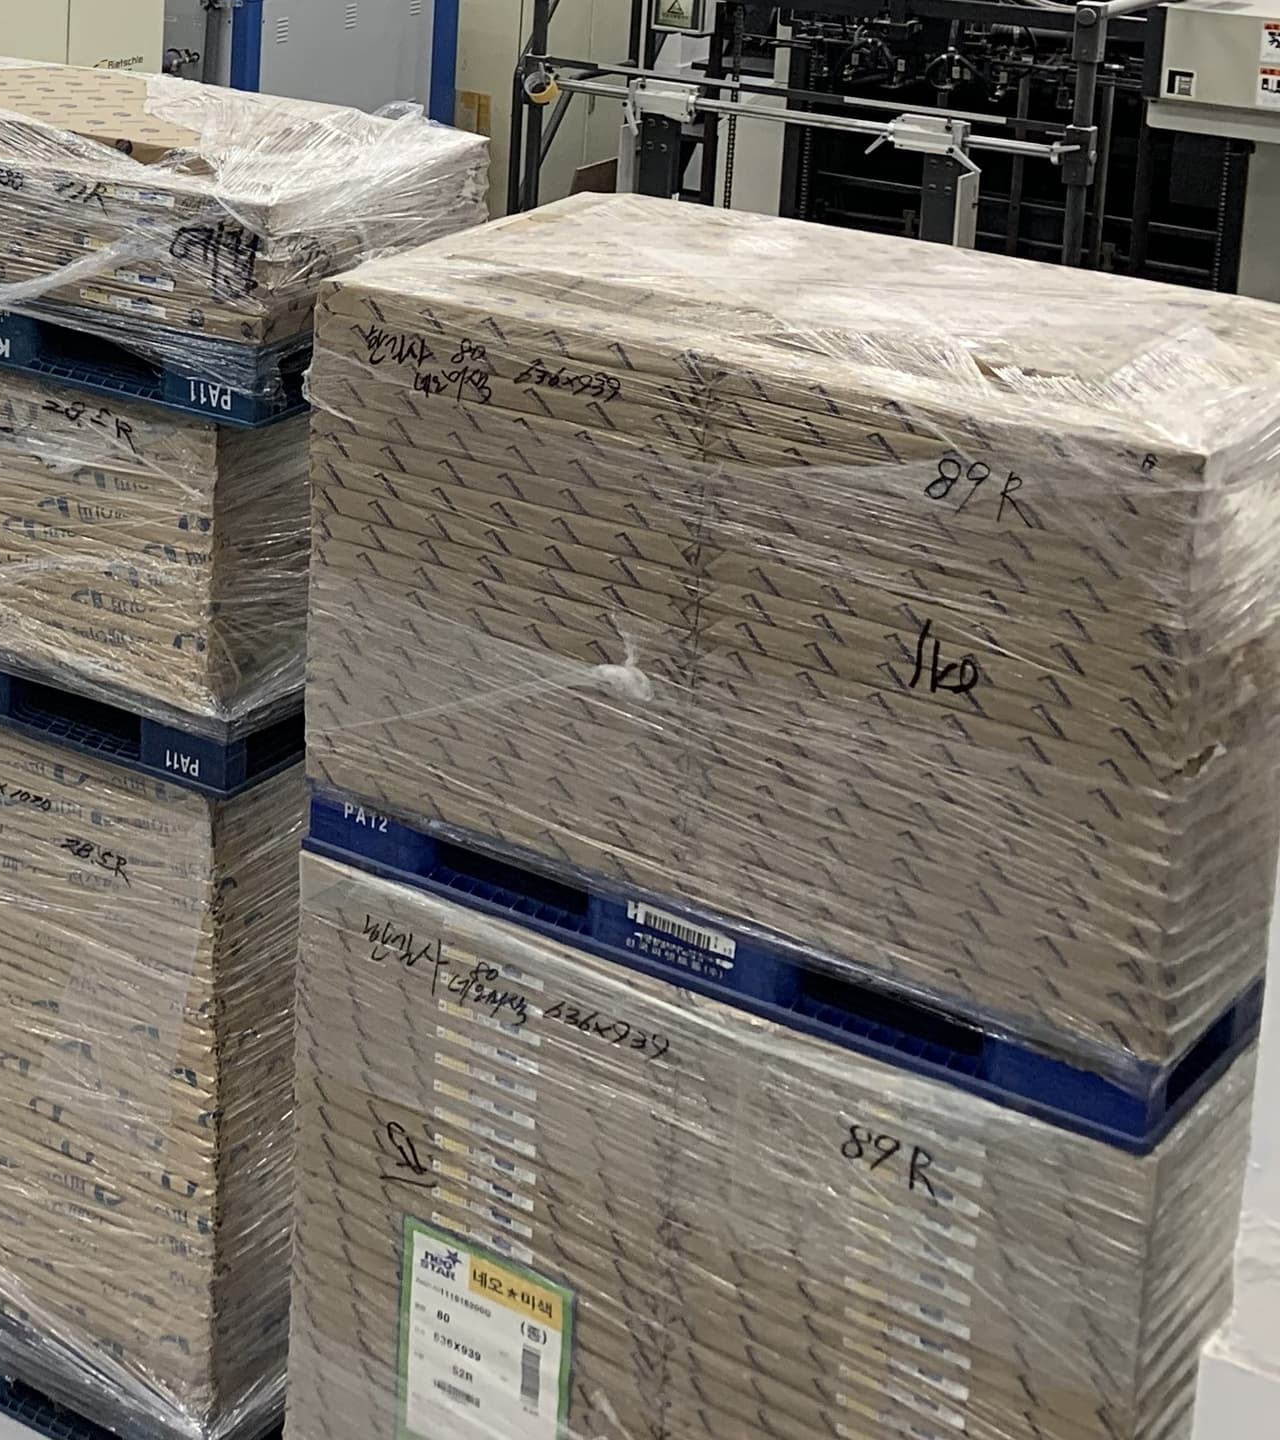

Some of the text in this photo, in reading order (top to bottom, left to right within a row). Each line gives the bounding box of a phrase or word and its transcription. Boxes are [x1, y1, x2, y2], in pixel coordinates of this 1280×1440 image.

[188, 378, 233, 411] PA11
[165, 749, 200, 778] PA11
[343, 801, 389, 834] PA12
